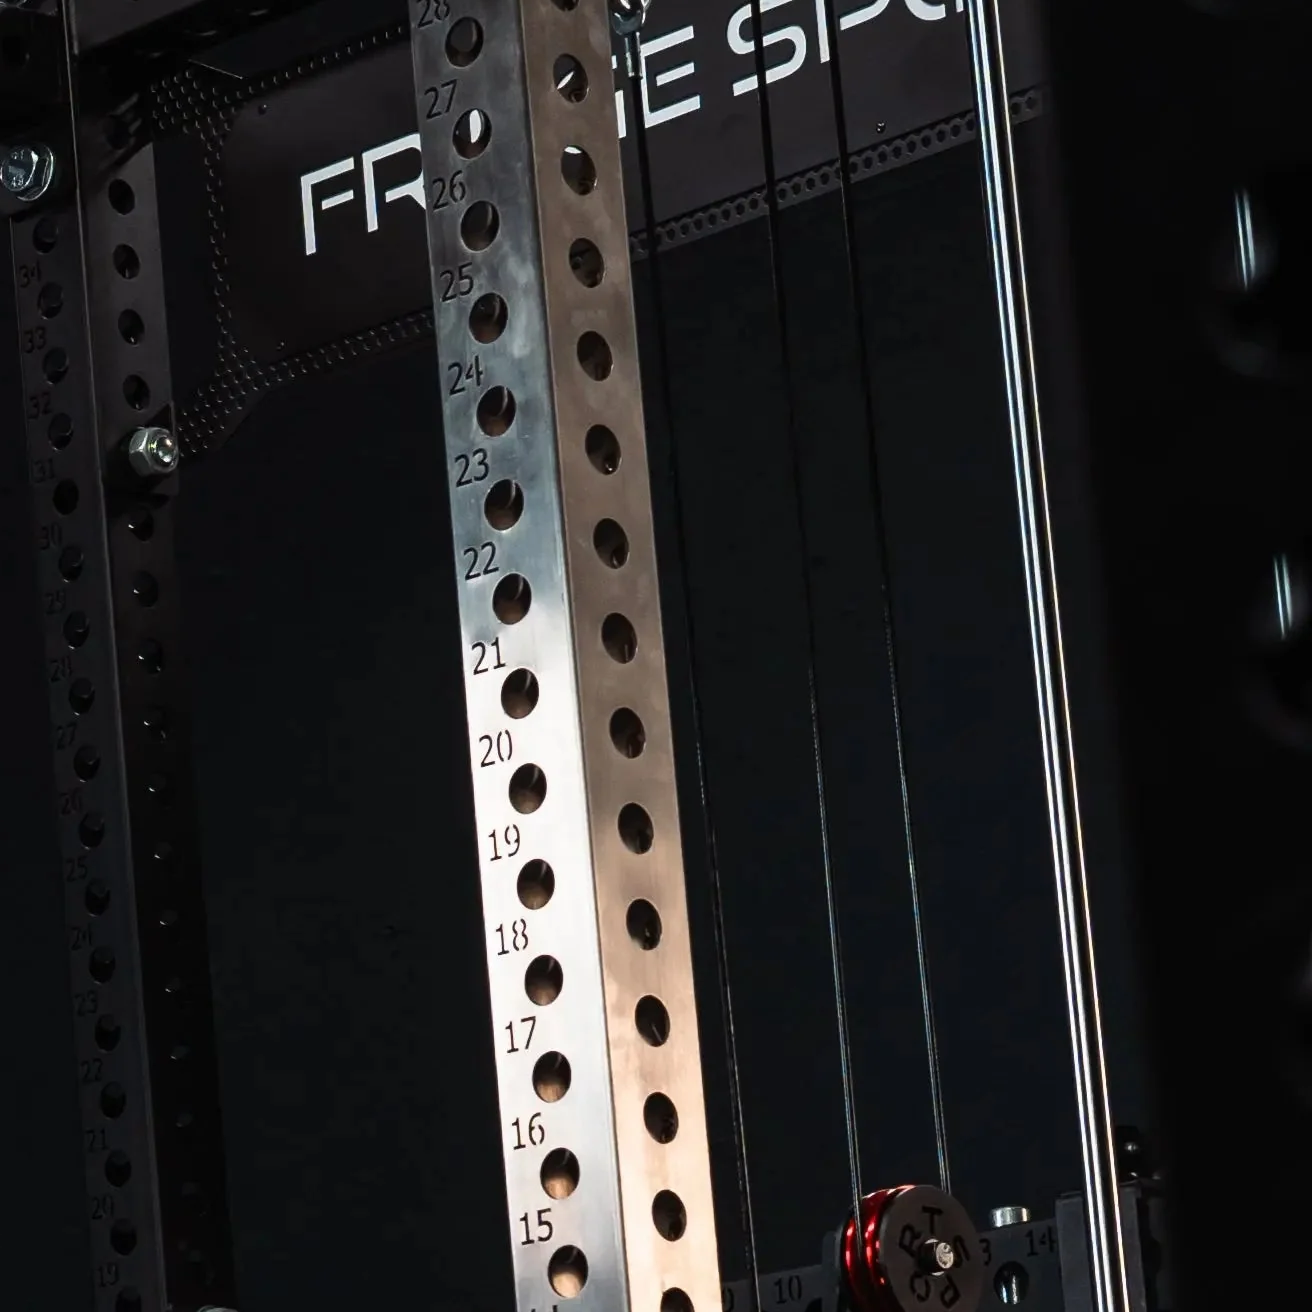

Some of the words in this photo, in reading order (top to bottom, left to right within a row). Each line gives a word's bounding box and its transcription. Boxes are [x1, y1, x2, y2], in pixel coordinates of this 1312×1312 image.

[424, 79, 458, 119] 27
[432, 170, 467, 210] 26
[439, 262, 474, 302] 25
[447, 355, 483, 395] 24
[454, 448, 490, 487] 23
[463, 541, 499, 581] 22
[471, 637, 506, 675] 21
[479, 729, 513, 767] 20
[488, 824, 520, 862] 19
[496, 918, 528, 956] 18
[505, 1016, 537, 1054] 17
[511, 1112, 545, 1150] 16
[519, 1208, 553, 1245] 15
[774, 1275, 803, 1306] 10
[1026, 1226, 1057, 1257] 14
